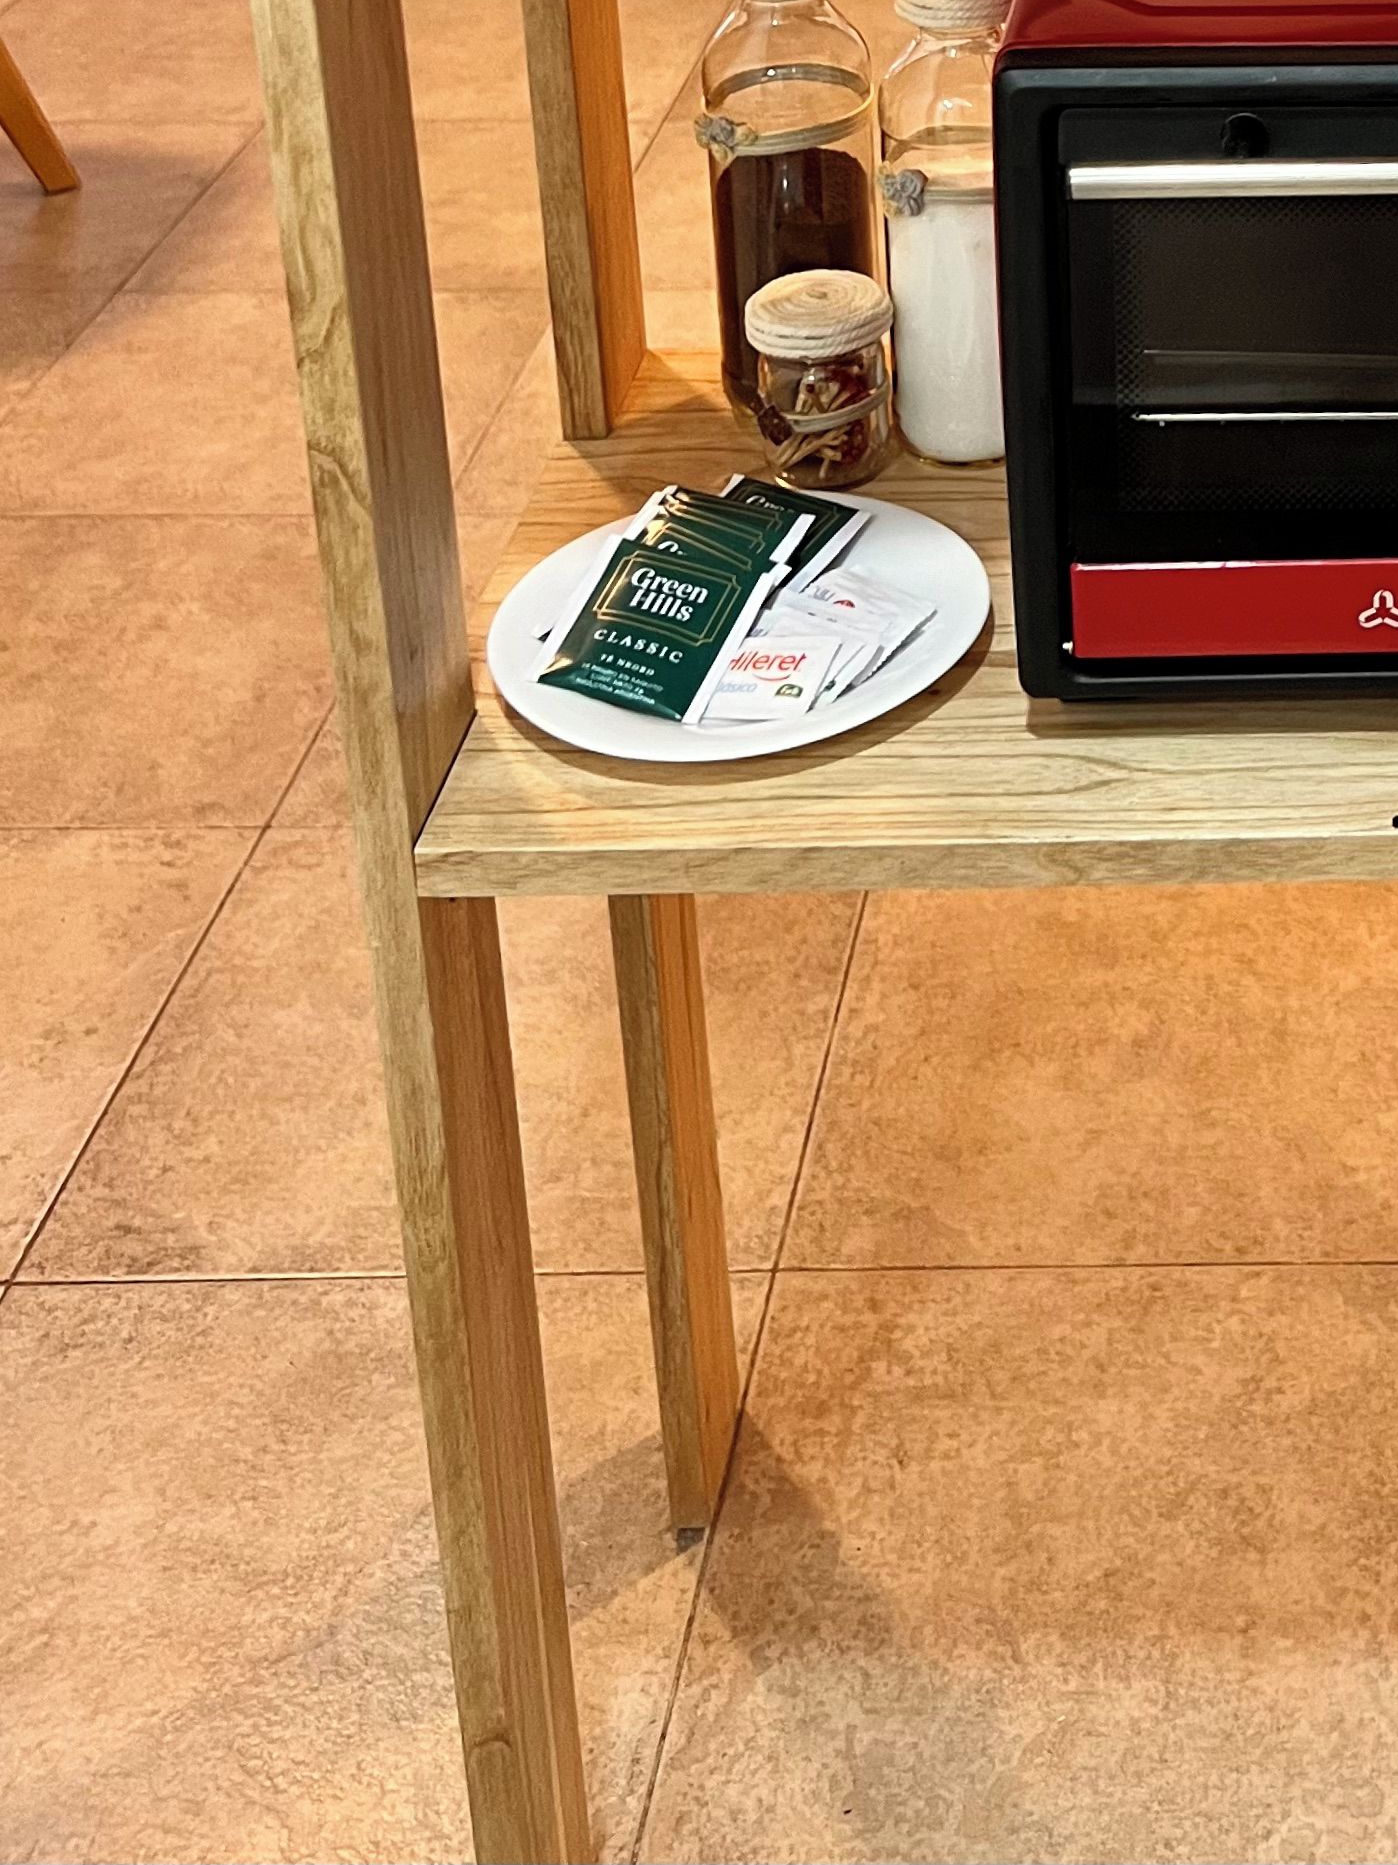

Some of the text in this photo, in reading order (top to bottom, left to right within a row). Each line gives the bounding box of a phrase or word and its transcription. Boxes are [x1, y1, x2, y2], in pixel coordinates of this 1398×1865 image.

[631, 567, 709, 604] Green
[629, 588, 694, 622] Hills
[593, 628, 684, 664] CLASSIC
